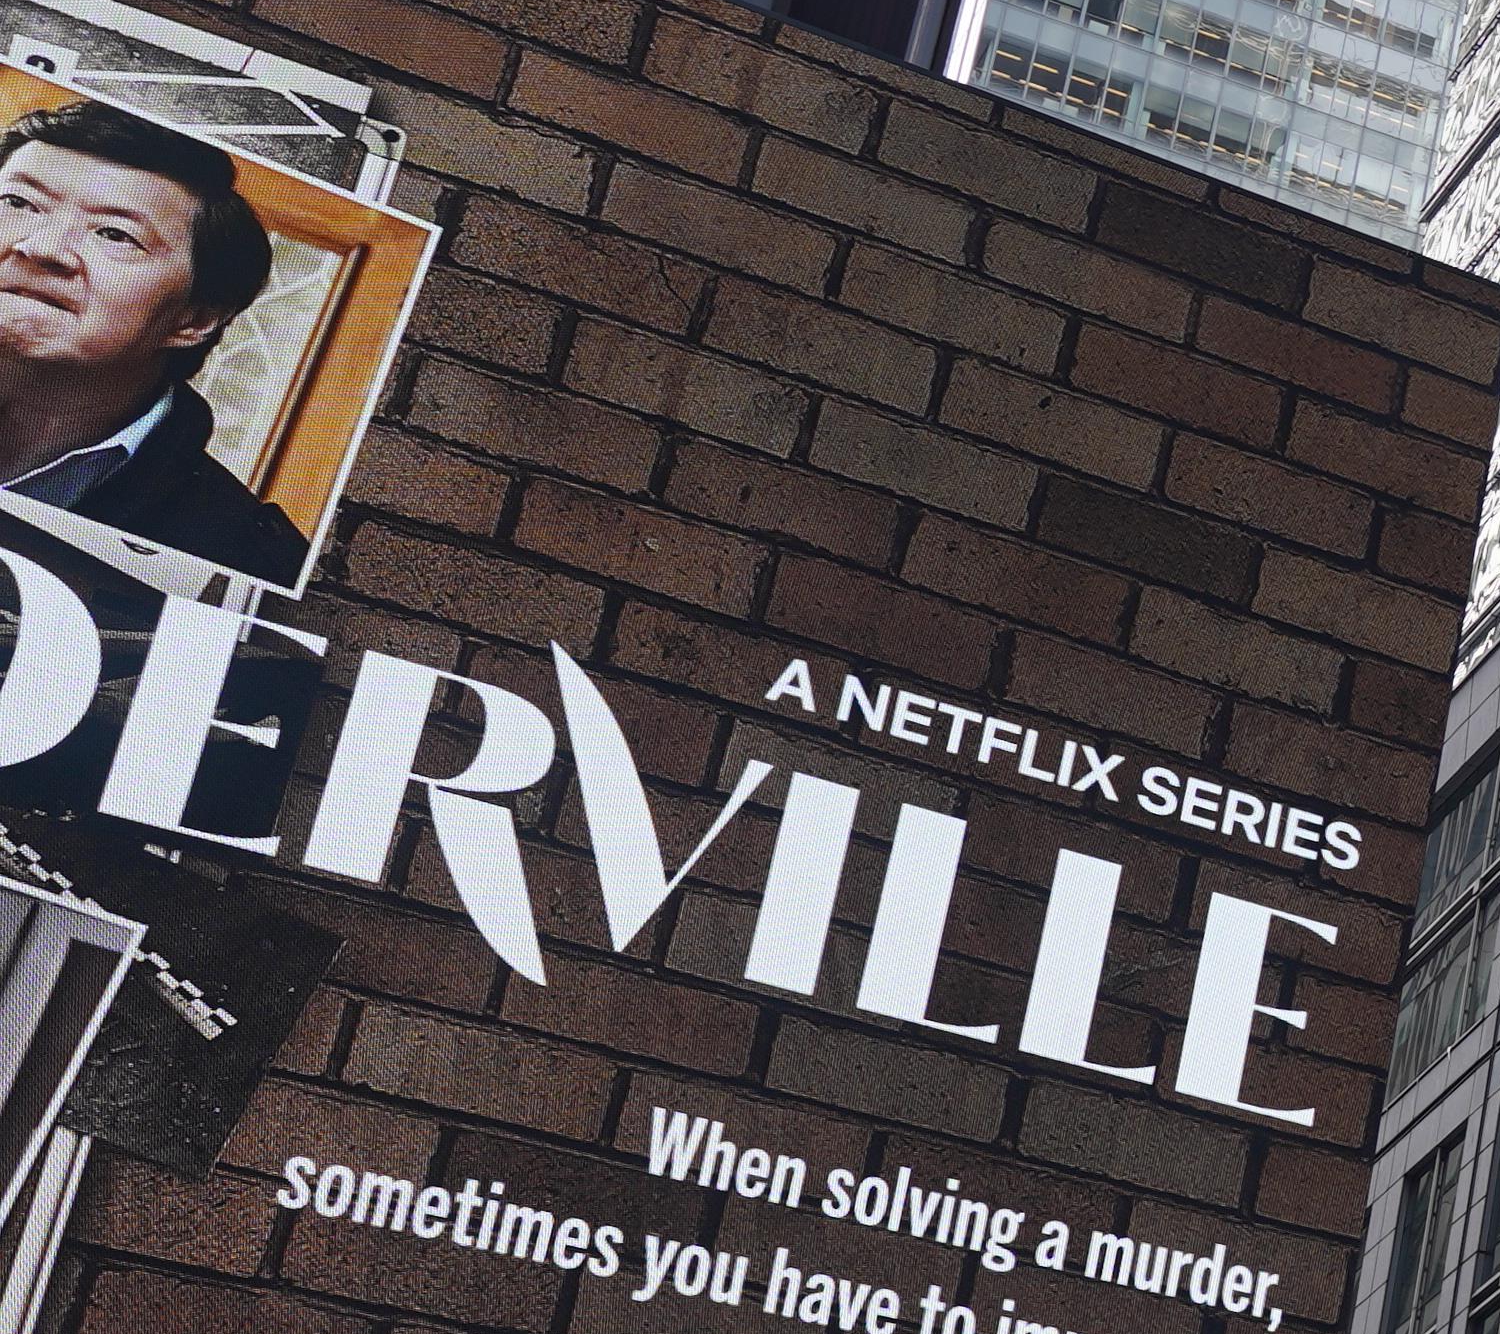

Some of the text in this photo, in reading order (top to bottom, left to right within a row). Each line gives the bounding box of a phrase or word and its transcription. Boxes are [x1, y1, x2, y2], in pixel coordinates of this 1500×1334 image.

[764, 658, 1365, 870] A NETFLIX SERIES
[275, 1153, 622, 1279] sometimes
[632, 1236, 748, 1310] you
[647, 1107, 1287, 1332] When solving a murder,
